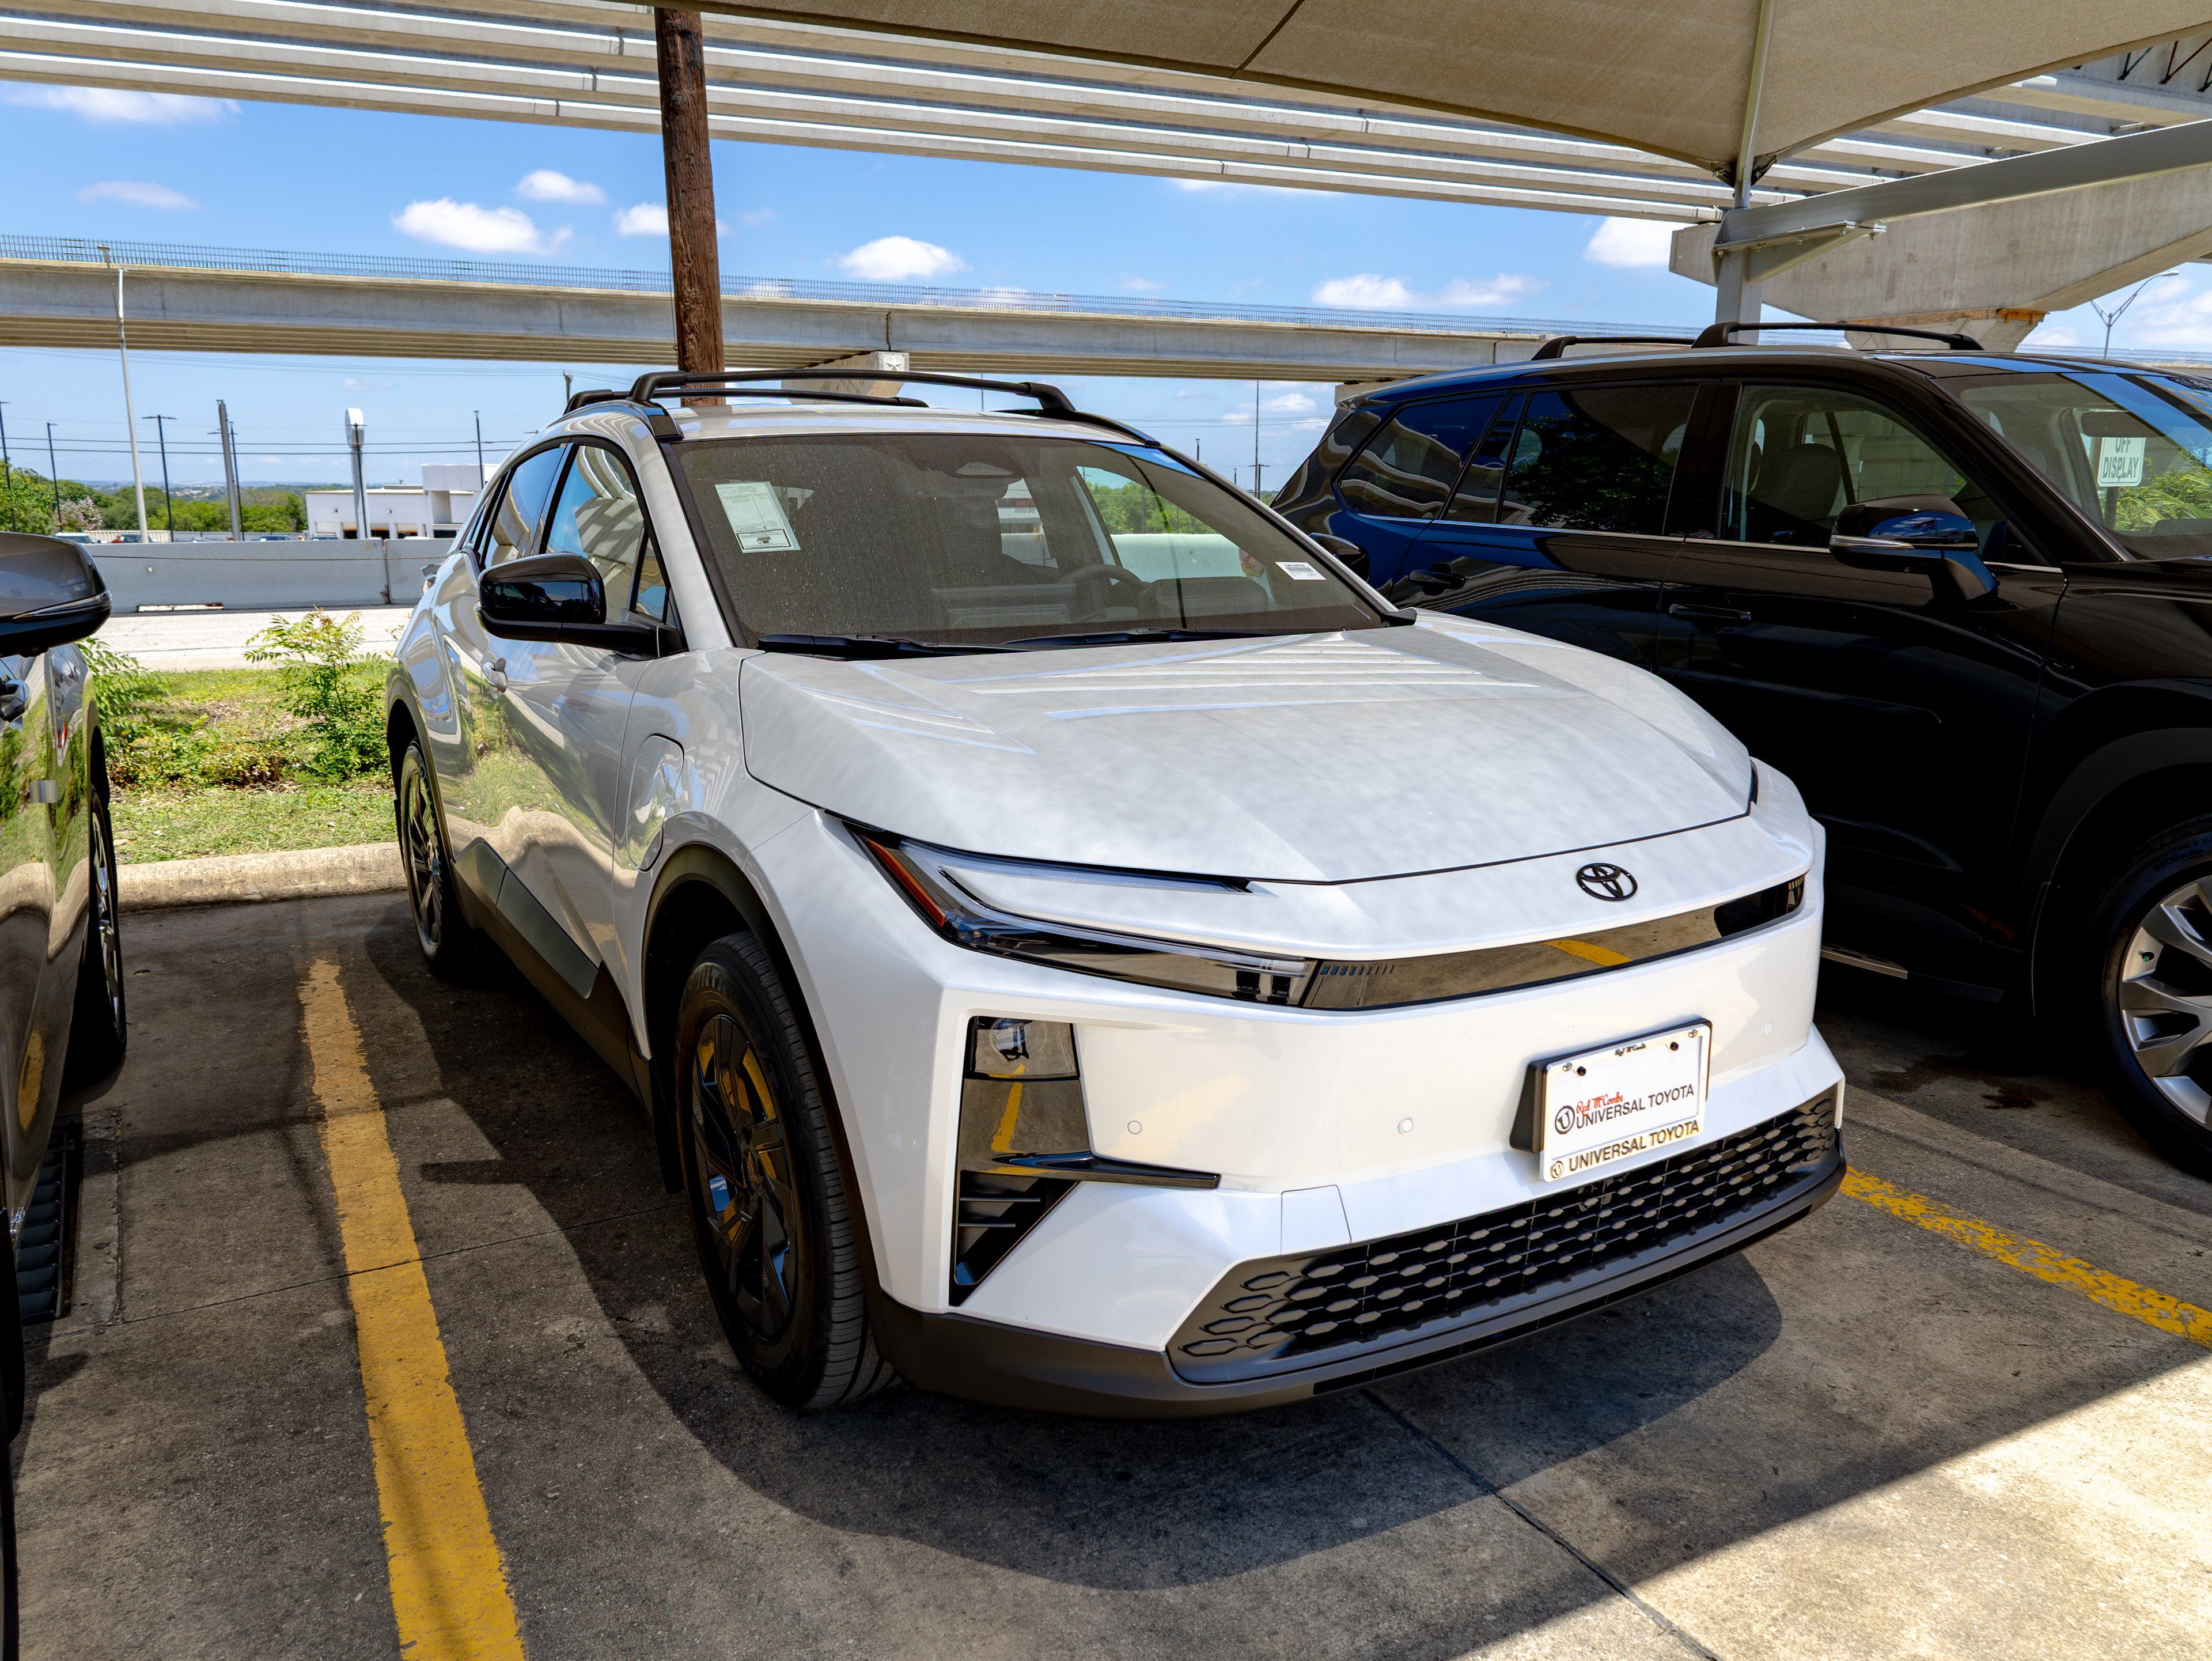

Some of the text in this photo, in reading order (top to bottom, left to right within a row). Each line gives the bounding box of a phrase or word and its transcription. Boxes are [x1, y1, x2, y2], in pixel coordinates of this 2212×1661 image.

[2115, 437, 2131, 453] OFF
[2103, 456, 2139, 479] DISPLAY
[1576, 1091, 1623, 1117] Red McCombs
[1577, 1098, 1646, 1129] UNIVERSAL
[1648, 1084, 1694, 1107] TOYOTA
[1569, 1136, 1646, 1171] UNIVERSAL
[1649, 1119, 1699, 1146] TOYOTA
